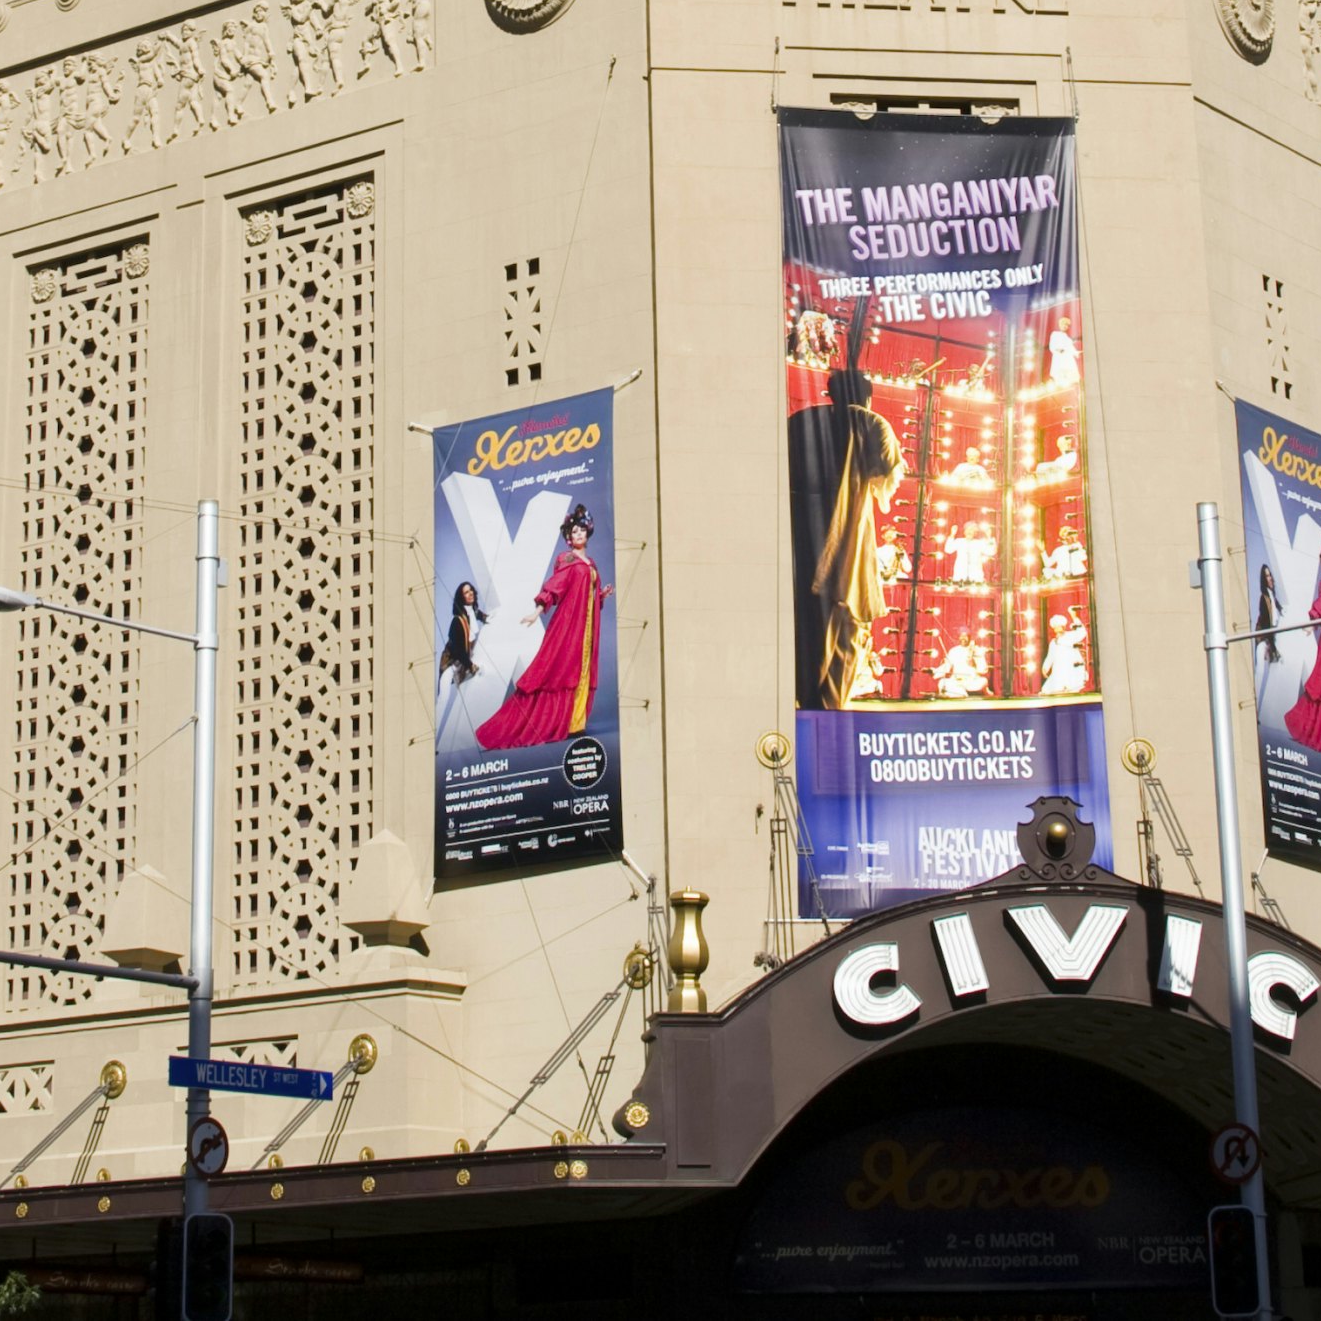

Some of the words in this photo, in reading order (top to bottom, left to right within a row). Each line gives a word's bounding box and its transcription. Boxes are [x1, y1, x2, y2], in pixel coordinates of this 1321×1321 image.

[795, 187, 857, 226] THE
[861, 174, 1060, 223] MANGANIYAR
[848, 216, 1022, 262] SEDUCTION
[818, 276, 873, 300] THREE
[874, 269, 1002, 296] PERFORMANCES
[1004, 263, 1044, 287] ONLY
[879, 295, 926, 324] THE
[931, 290, 993, 321] CIVIC
[467, 422, 601, 476] Xerxes
[858, 729, 1037, 757] BUYTICKETS.CO.NZ
[1265, 744, 1271, 756] 2
[446, 769, 453, 782] 2
[461, 766, 469, 778] 6
[470, 759, 509, 777] MARCH
[870, 756, 1034, 784] 0800BUYTICKETS
[446, 792, 524, 813] www.nzopera.com
[573, 800, 610, 815] OPERA
[833, 904, 1321, 1041] CIVIC
[196, 1063, 267, 1089] WELLESLEY
[845, 1140, 1110, 1211] Xerxes
[946, 1233, 957, 1249] 2
[975, 1233, 986, 1249] 6
[990, 1231, 1055, 1249] MARCH
[1098, 1237, 1129, 1249] NBR
[924, 1252, 1079, 1270] www.nzopera.com
[1139, 1246, 1207, 1265] OPERA
